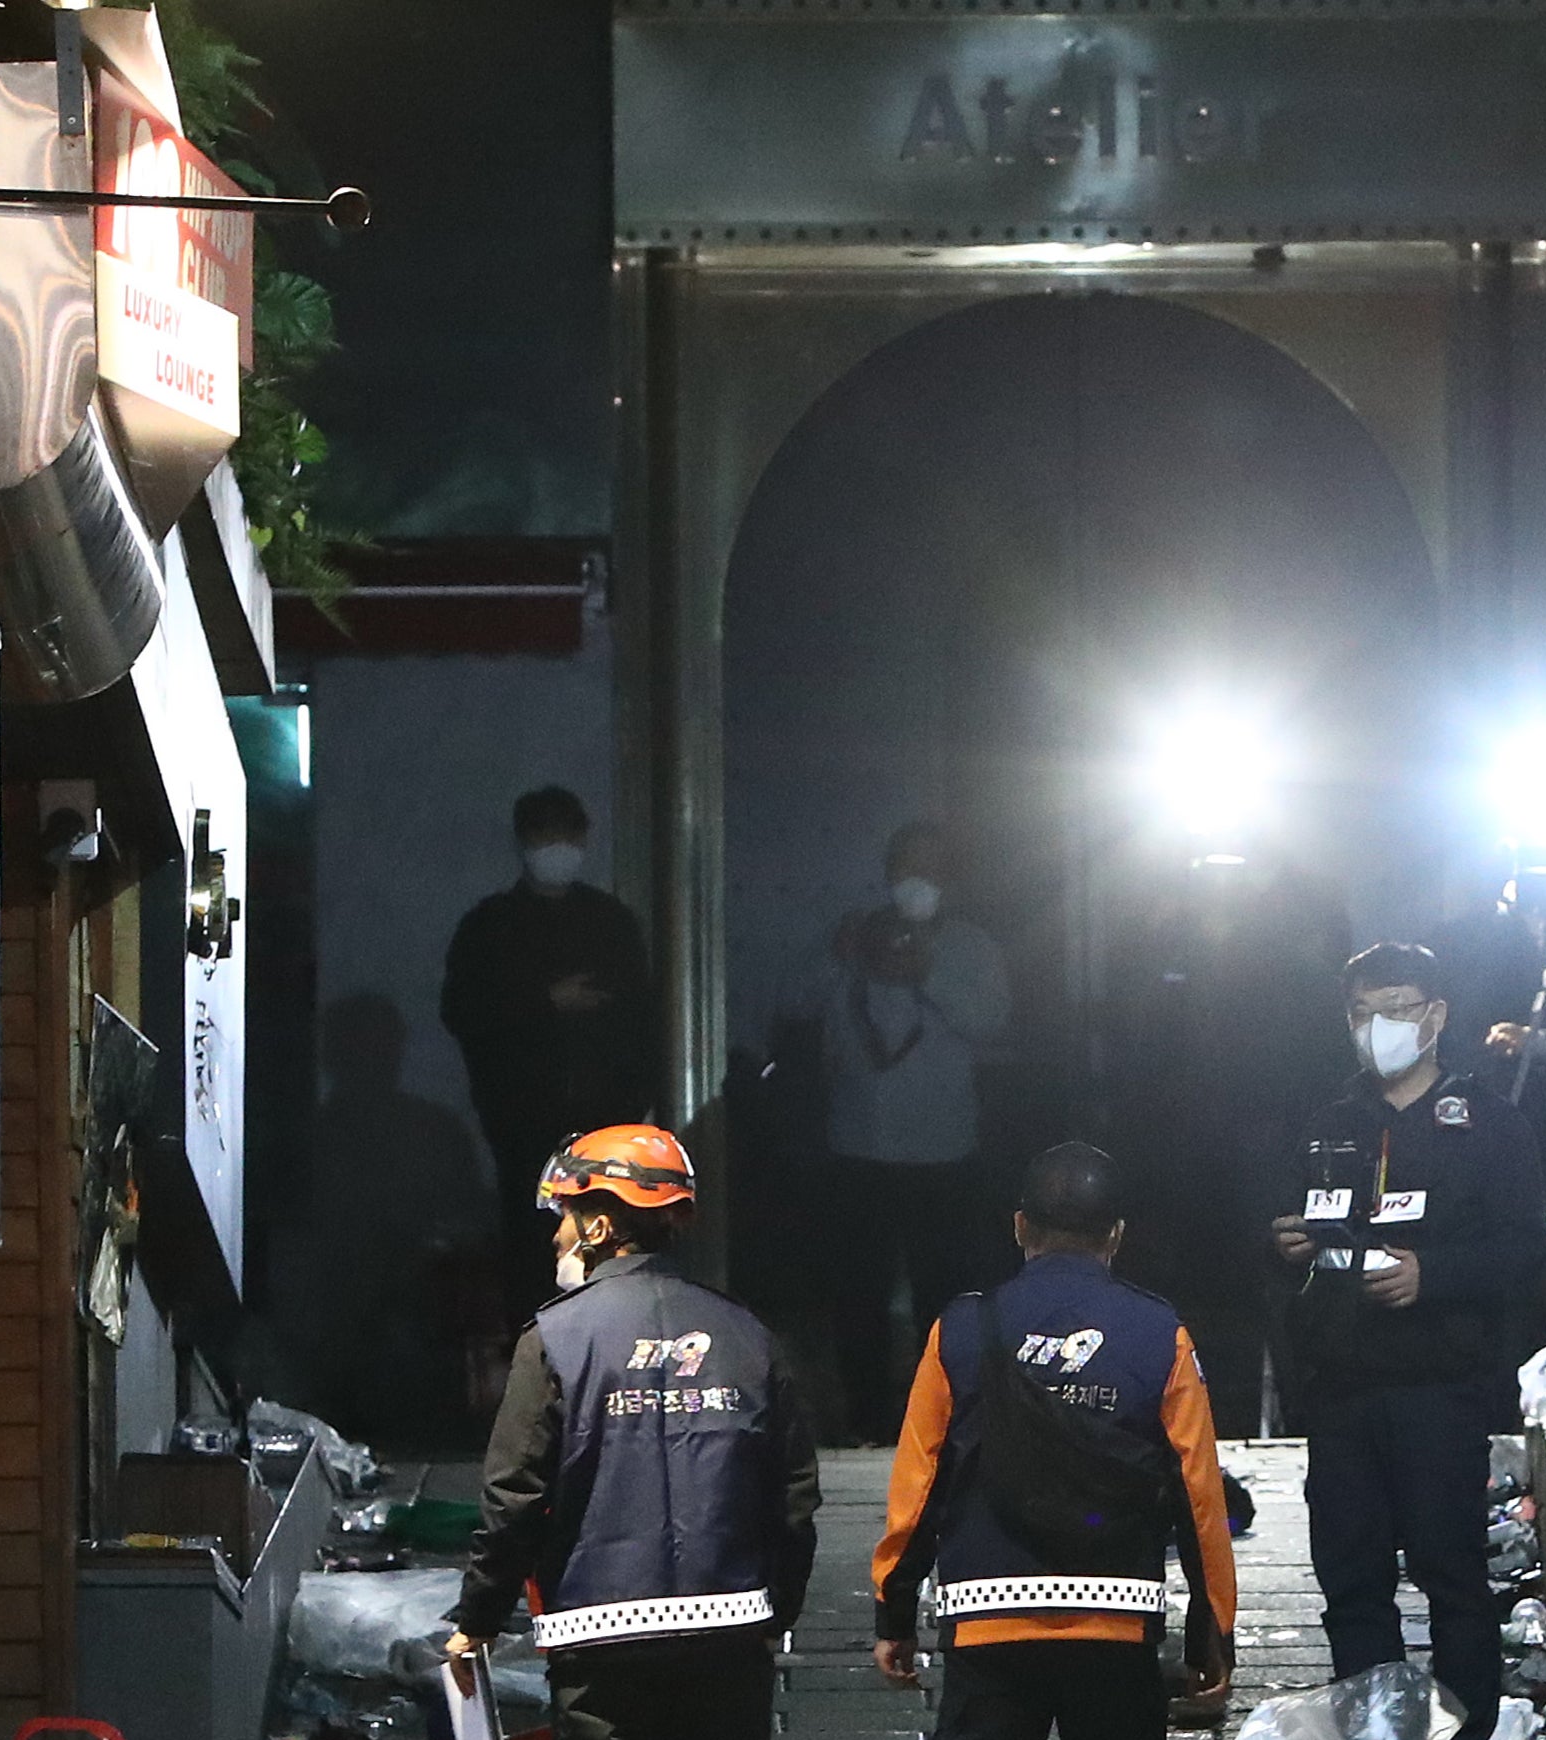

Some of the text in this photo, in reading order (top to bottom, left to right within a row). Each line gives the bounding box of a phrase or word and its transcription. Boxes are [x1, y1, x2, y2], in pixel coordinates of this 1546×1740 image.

[124, 284, 183, 339] LUXURY
[155, 349, 215, 405] LOUNGE
[626, 1331, 712, 1377] 119
[1016, 1328, 1105, 1374] 119
